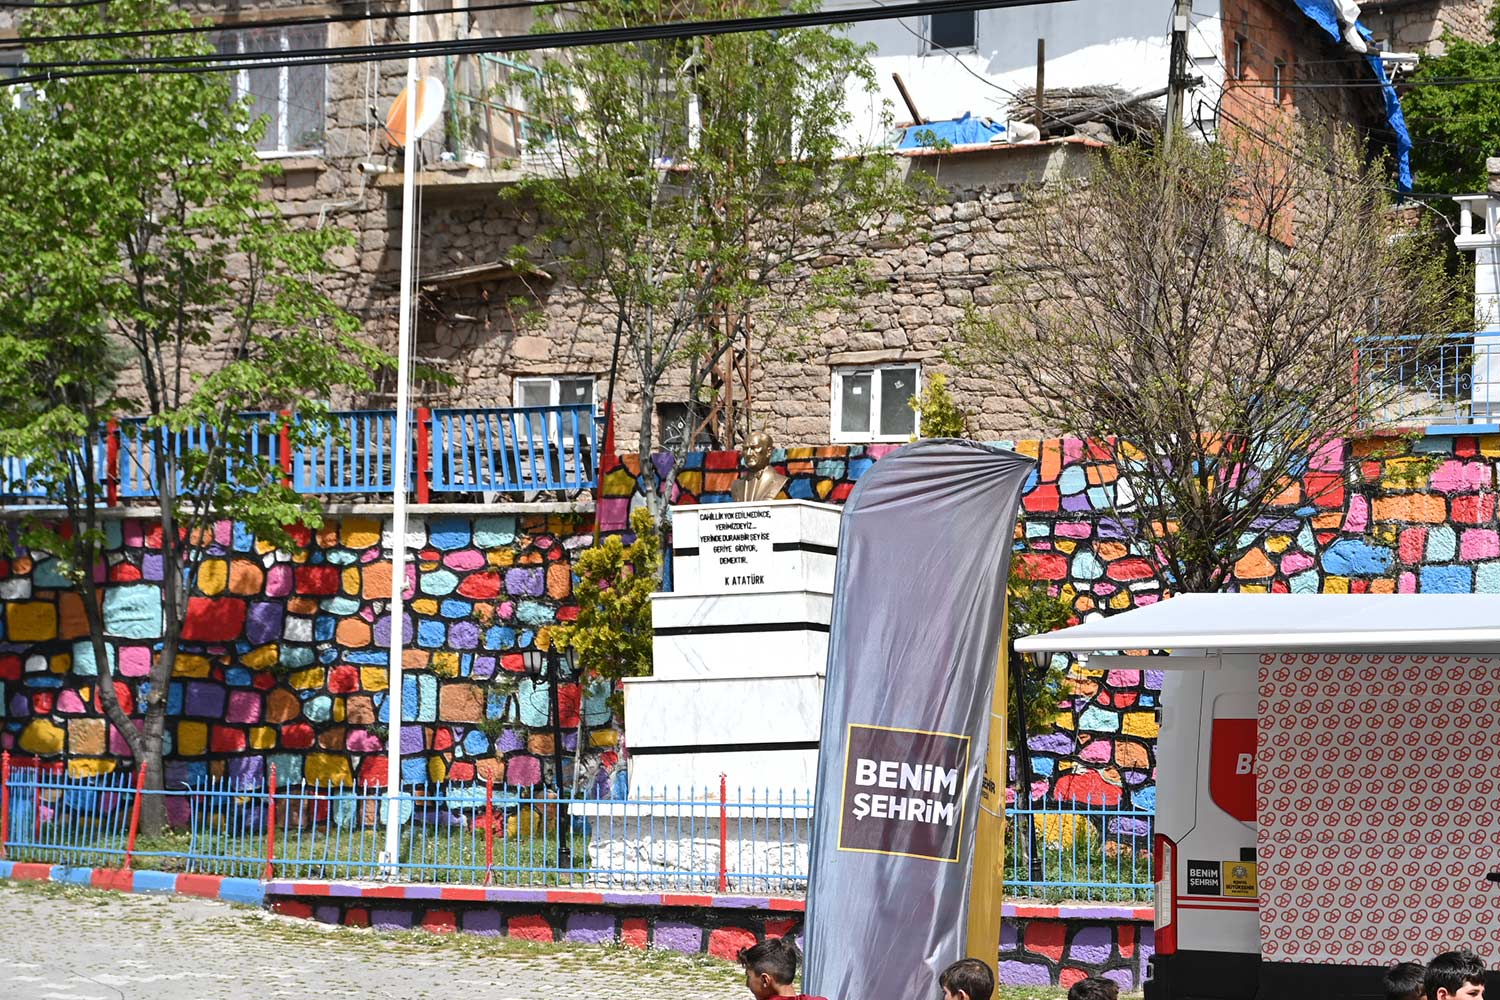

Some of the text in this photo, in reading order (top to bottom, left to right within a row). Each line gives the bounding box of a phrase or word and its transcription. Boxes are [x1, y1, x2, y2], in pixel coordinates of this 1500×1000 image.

[724, 512, 734, 520] YOK
[722, 534, 740, 542] DURAN
[732, 573, 764, 586] ATATÜRK
